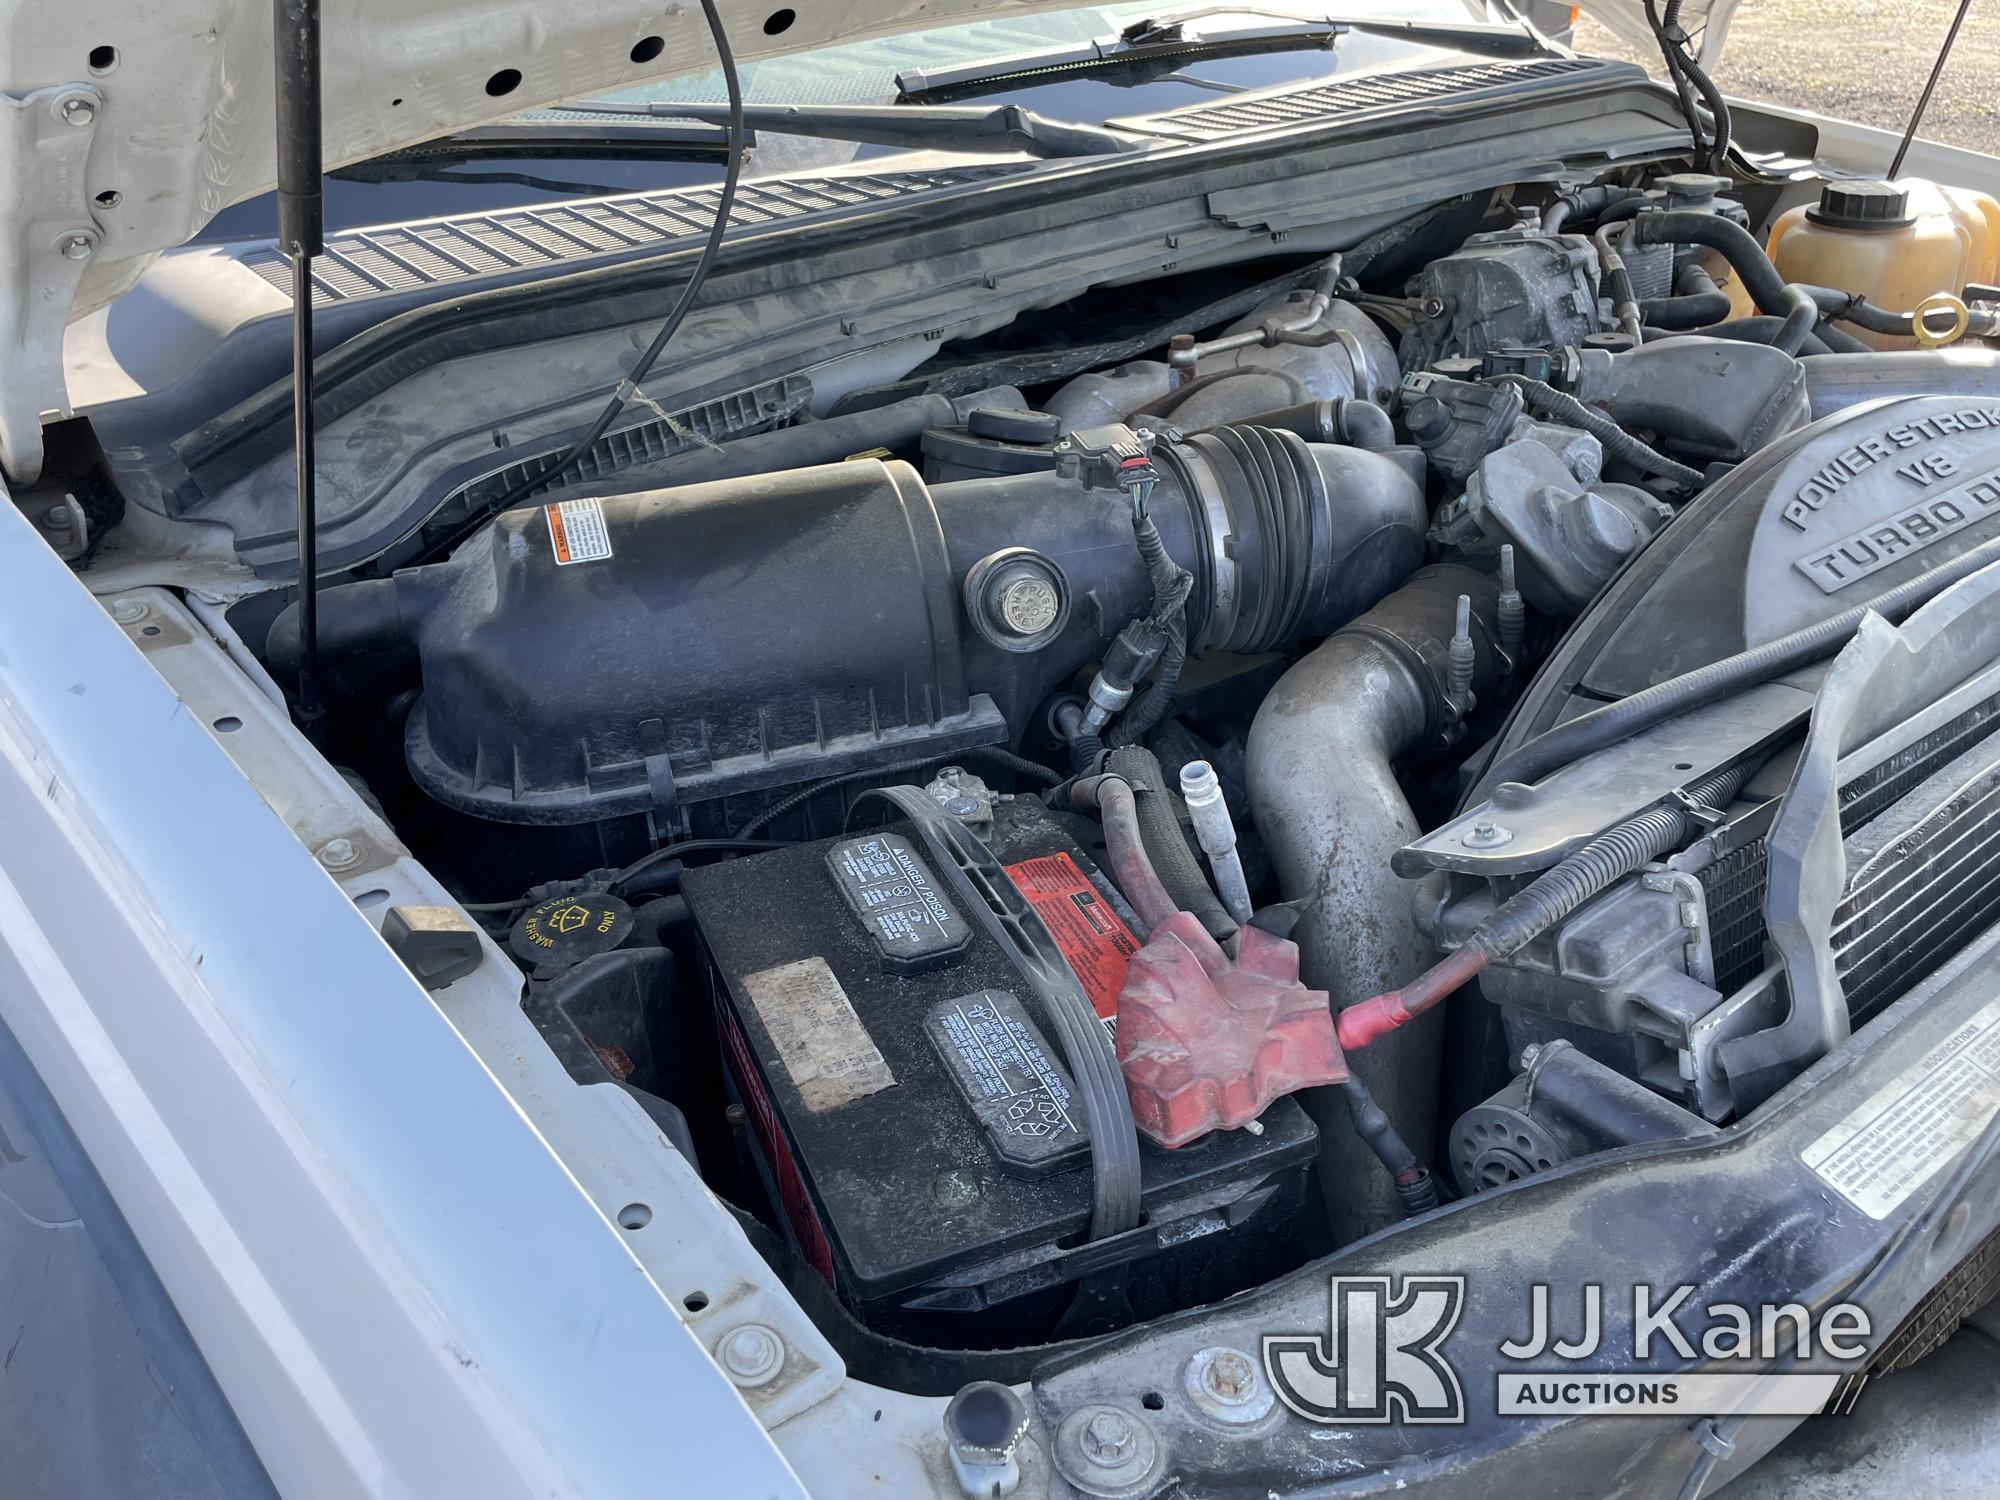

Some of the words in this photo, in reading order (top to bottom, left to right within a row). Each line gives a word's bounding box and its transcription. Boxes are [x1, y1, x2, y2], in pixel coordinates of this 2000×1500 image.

[1782, 438, 1892, 531] POWER
[1898, 454, 1960, 486] V8
[1809, 500, 1965, 579] TURBO
[1012, 593, 1036, 625] RESET
[1029, 586, 1051, 614] PUSH
[536, 896, 577, 915] FLUID
[897, 854, 924, 885] DANGER
[921, 890, 949, 921] POISON
[526, 917, 555, 949] WASHER
[597, 910, 615, 933] ONLY
[971, 1023, 990, 1044] MEDICAL
[984, 1044, 999, 1059] HELP
[993, 1057, 1008, 1071] FAST
[981, 1020, 995, 1034] WITH
[1001, 1052, 1013, 1063] GET
[988, 1018, 1005, 1035] FLUSH
[999, 1033, 1013, 1047] EYES
[1007, 1047, 1035, 1081] IMMEDIATELY
[1015, 1022, 1026, 1032] KEEP
[1022, 1032, 1031, 1041] OUT
[1032, 1048, 1041, 1056] THE
[1038, 1056, 1051, 1071] REACH
[1051, 1077, 1070, 1099] CHILDREN
[1921, 1023, 1981, 1071] MODIFICATIONS
[992, 1077, 1007, 1094] FOLLOW
[1007, 1022, 1017, 1031] NOT
[1019, 1039, 1030, 1050] KEEP
[1041, 1073, 1054, 1086] TIGHT
[1050, 1086, 1060, 1096] AND
[1056, 1096, 1069, 1109] LEVEL
[998, 1114, 1016, 1137] RECYCLE
